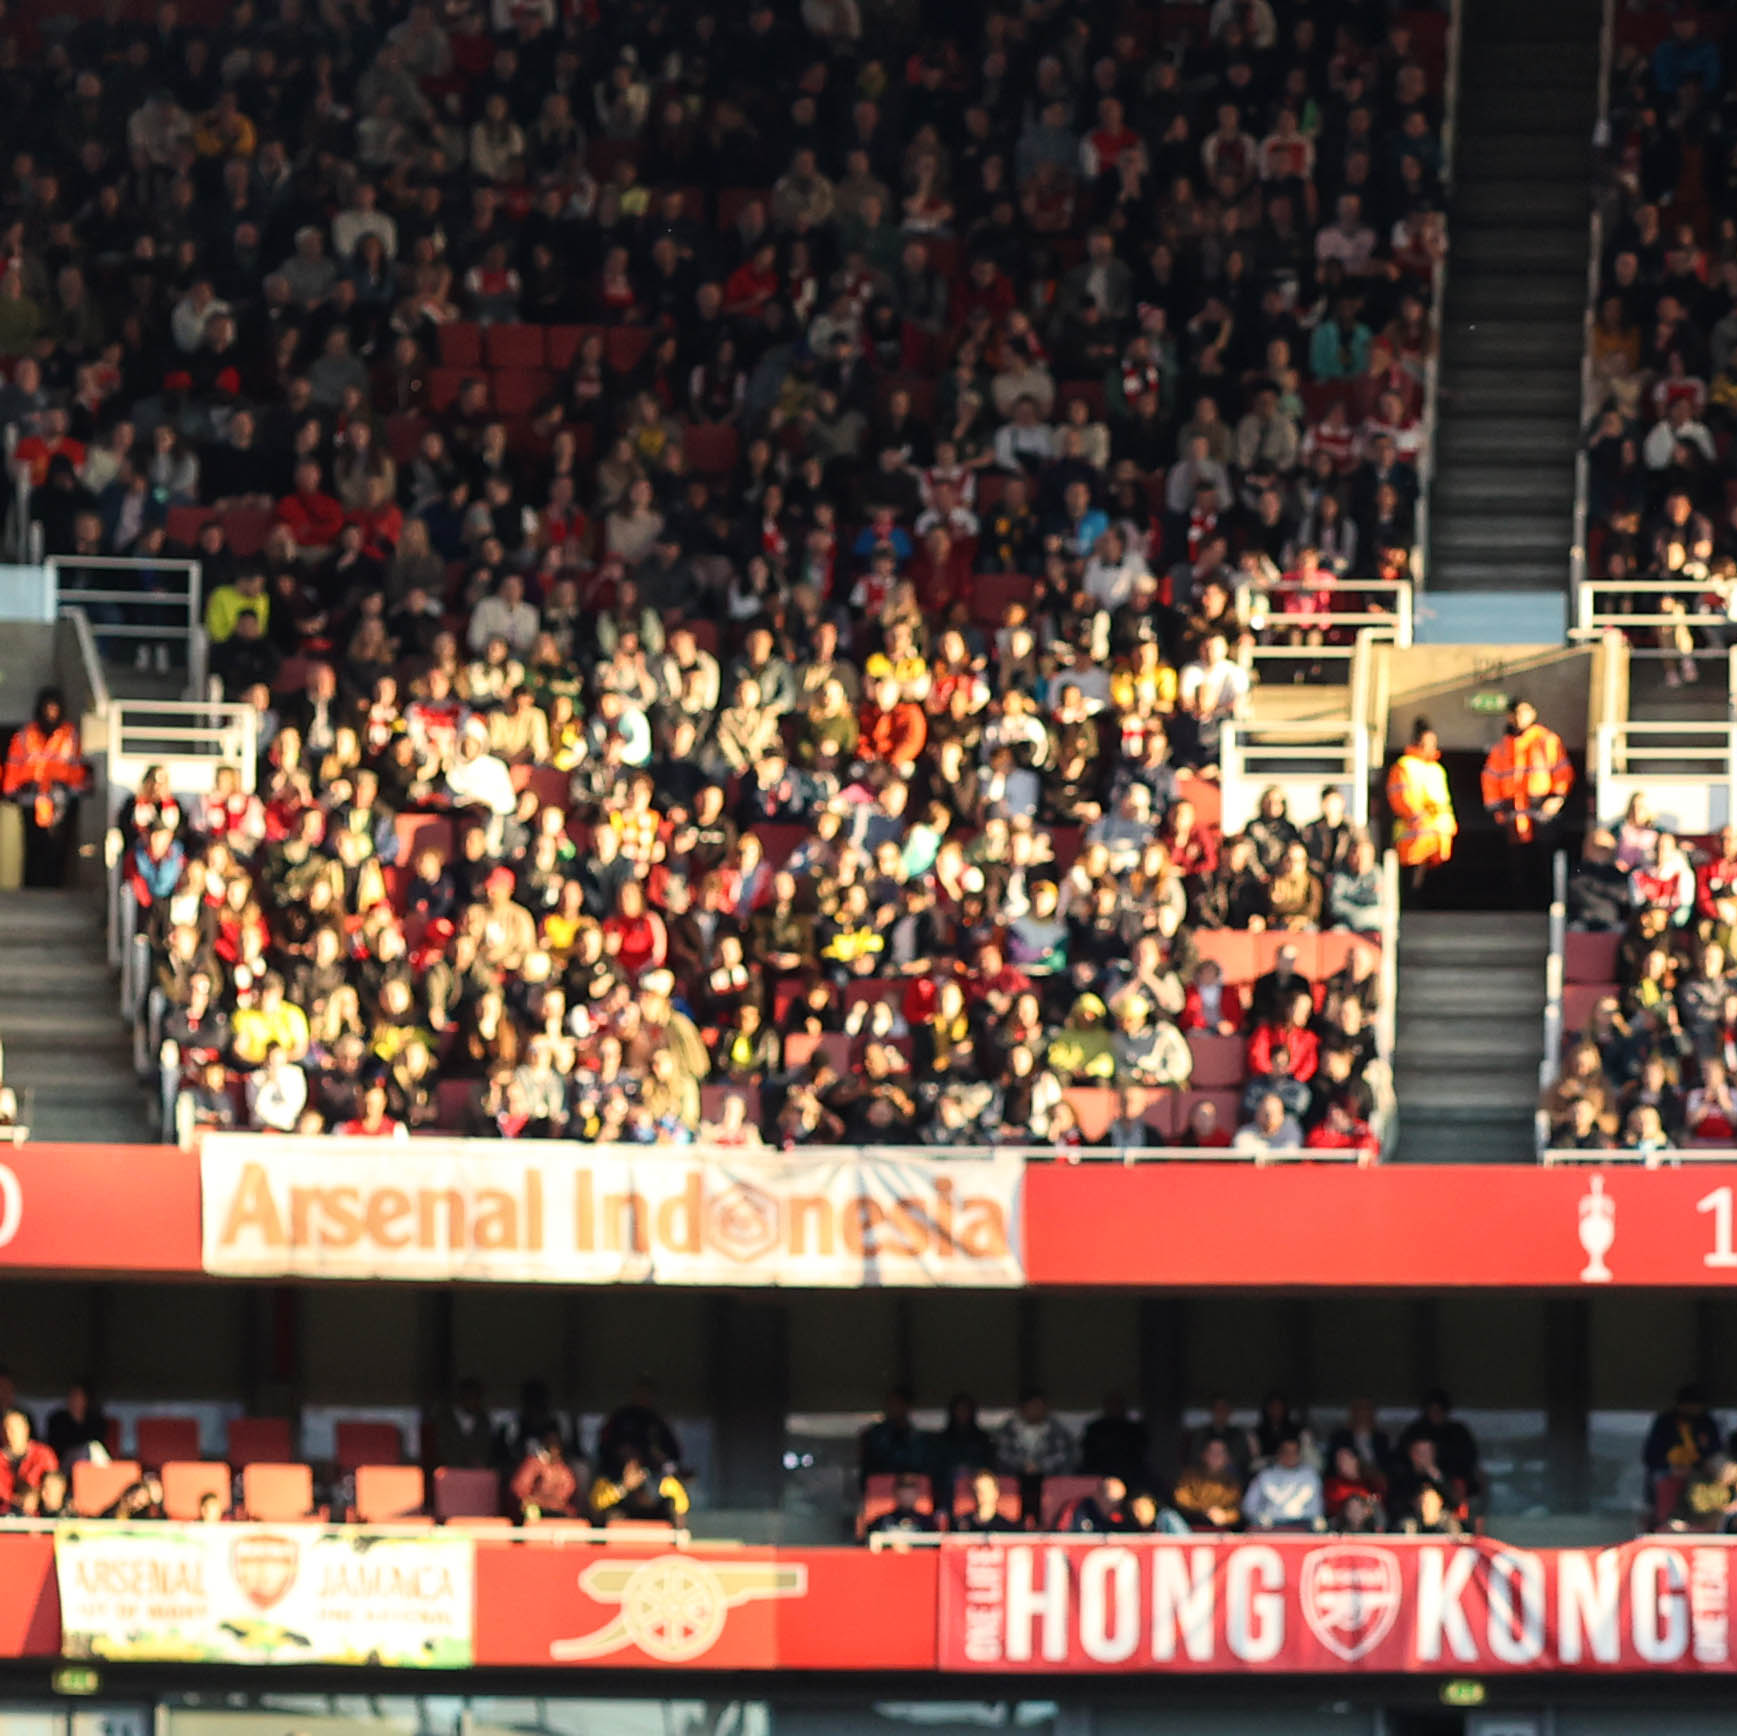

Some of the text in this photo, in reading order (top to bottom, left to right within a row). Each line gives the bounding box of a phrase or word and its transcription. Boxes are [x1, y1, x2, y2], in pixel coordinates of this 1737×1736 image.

[219, 1161, 542, 1252] Arsenal
[1005, 1545, 1690, 1664] HONG KONG
